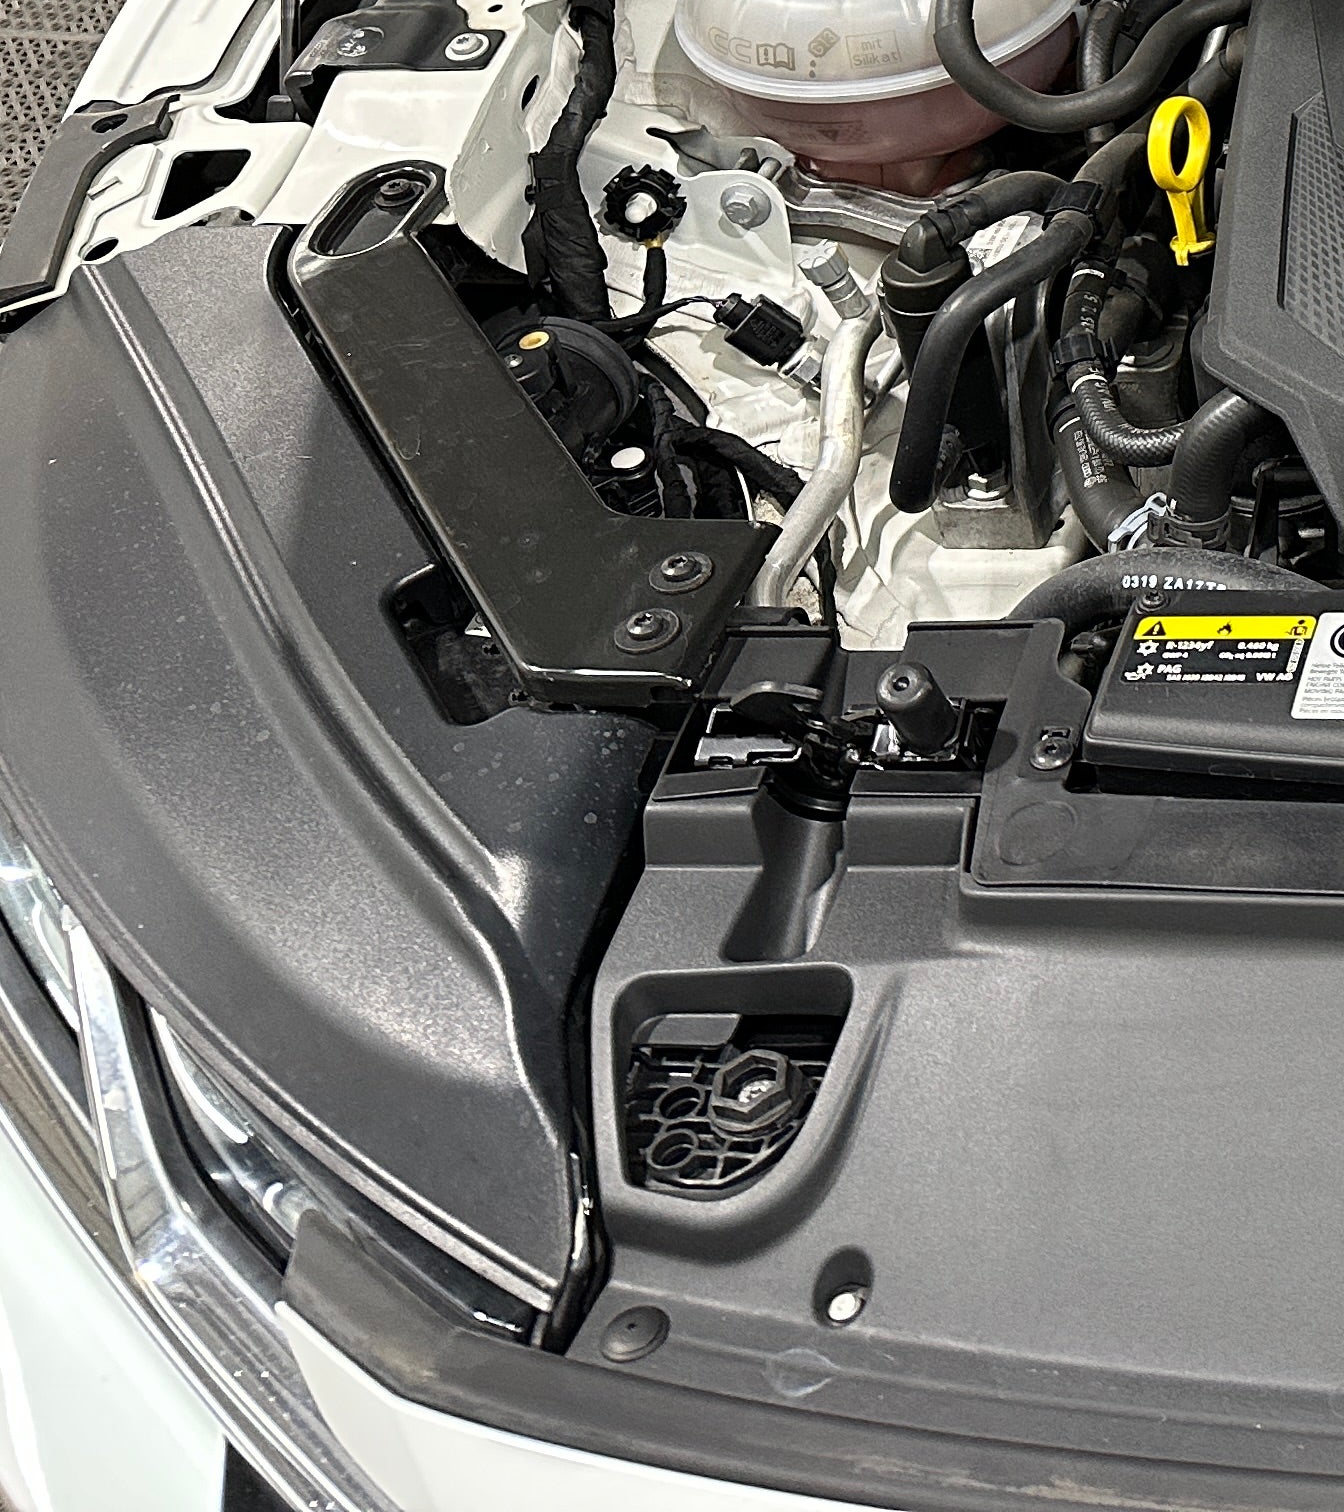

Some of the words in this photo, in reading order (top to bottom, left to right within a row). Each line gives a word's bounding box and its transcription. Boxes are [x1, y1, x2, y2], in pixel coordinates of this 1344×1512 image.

[861, 39, 882, 51] mit
[853, 51, 898, 67] Silikat
[1121, 574, 1158, 589] 0319
[1156, 664, 1183, 674] PAG
[1255, 672, 1276, 682] VW
[1275, 672, 1294, 682] AG
